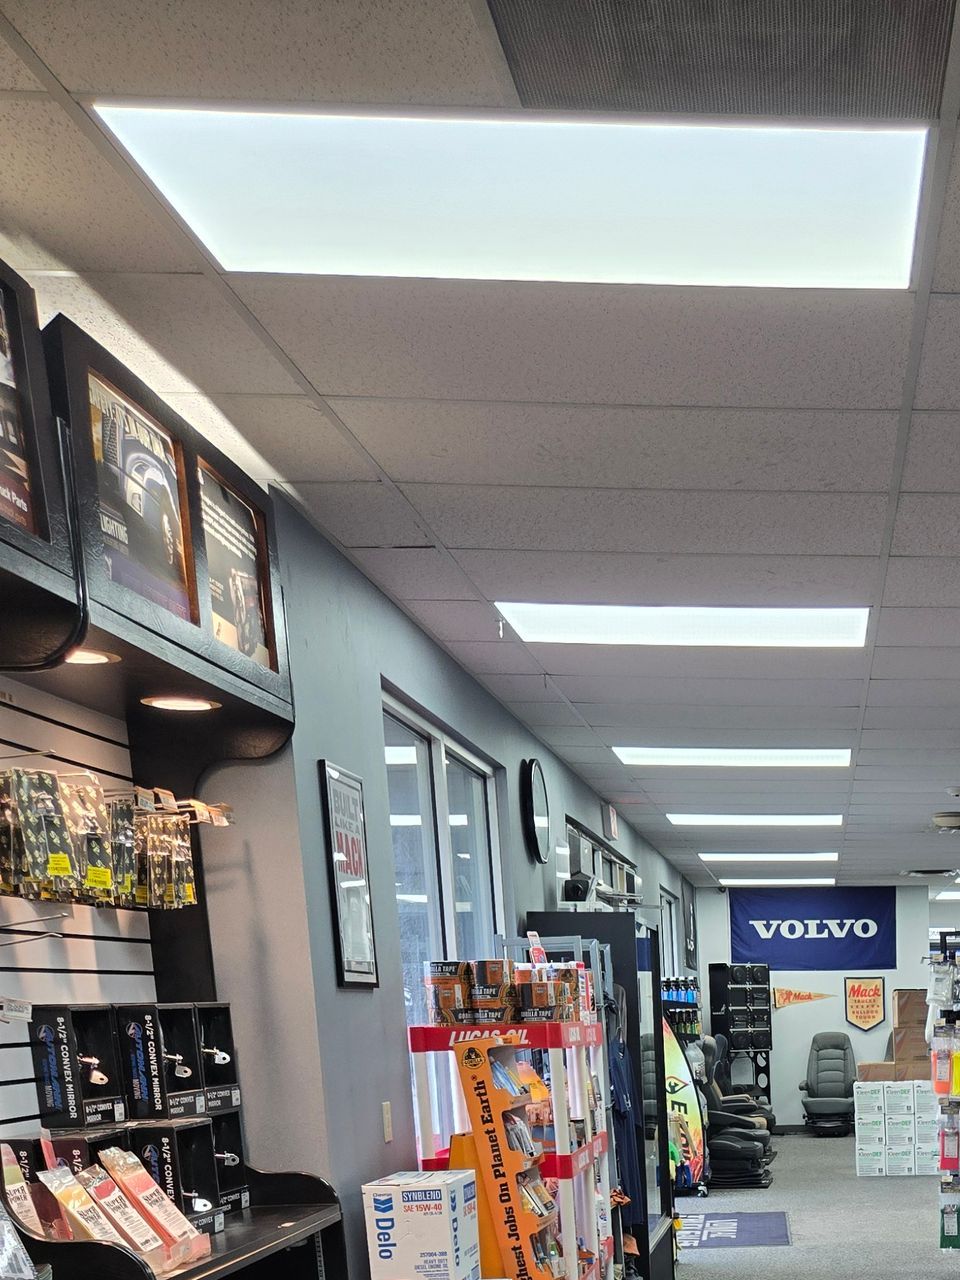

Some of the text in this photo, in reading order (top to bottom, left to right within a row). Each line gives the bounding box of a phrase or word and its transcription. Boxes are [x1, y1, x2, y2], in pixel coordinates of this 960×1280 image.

[12, 489, 28, 512] Parts
[100, 515, 128, 544] LIGHTING
[333, 788, 358, 821] BUILT
[335, 817, 353, 833] LIKE
[336, 831, 363, 878] MACK
[749, 919, 878, 939] VOLVO
[793, 992, 813, 1000] Mack
[848, 984, 881, 998] Mack
[57, 1017, 78, 1119] 8-1/2" CONVEX MIRROR
[145, 1015, 162, 1111] 8-1/2" CONVEX MIRROR
[97, 1103, 113, 1112] CONVEX
[474, 1079, 494, 1124] Earth
[484, 1128, 507, 1178] Planet
[162, 1137, 176, 1205] 8-1/2" CONVEX
[7, 1185, 27, 1197] SUPER
[142, 1189, 161, 1202] SUPER
[402, 1190, 441, 1202] SYNBLEND
[500, 1182, 511, 1203] On
[7, 1195, 27, 1204] POWER
[105, 1195, 124, 1209] SUPER
[148, 1195, 165, 1208] POWER
[78, 1206, 96, 1219] SUPER
[109, 1202, 128, 1215] POWER
[403, 1203, 442, 1213] SAE 15W-40
[82, 1212, 100, 1225] POWER
[504, 1206, 520, 1241] Jobs
[375, 1217, 397, 1260] Delo
